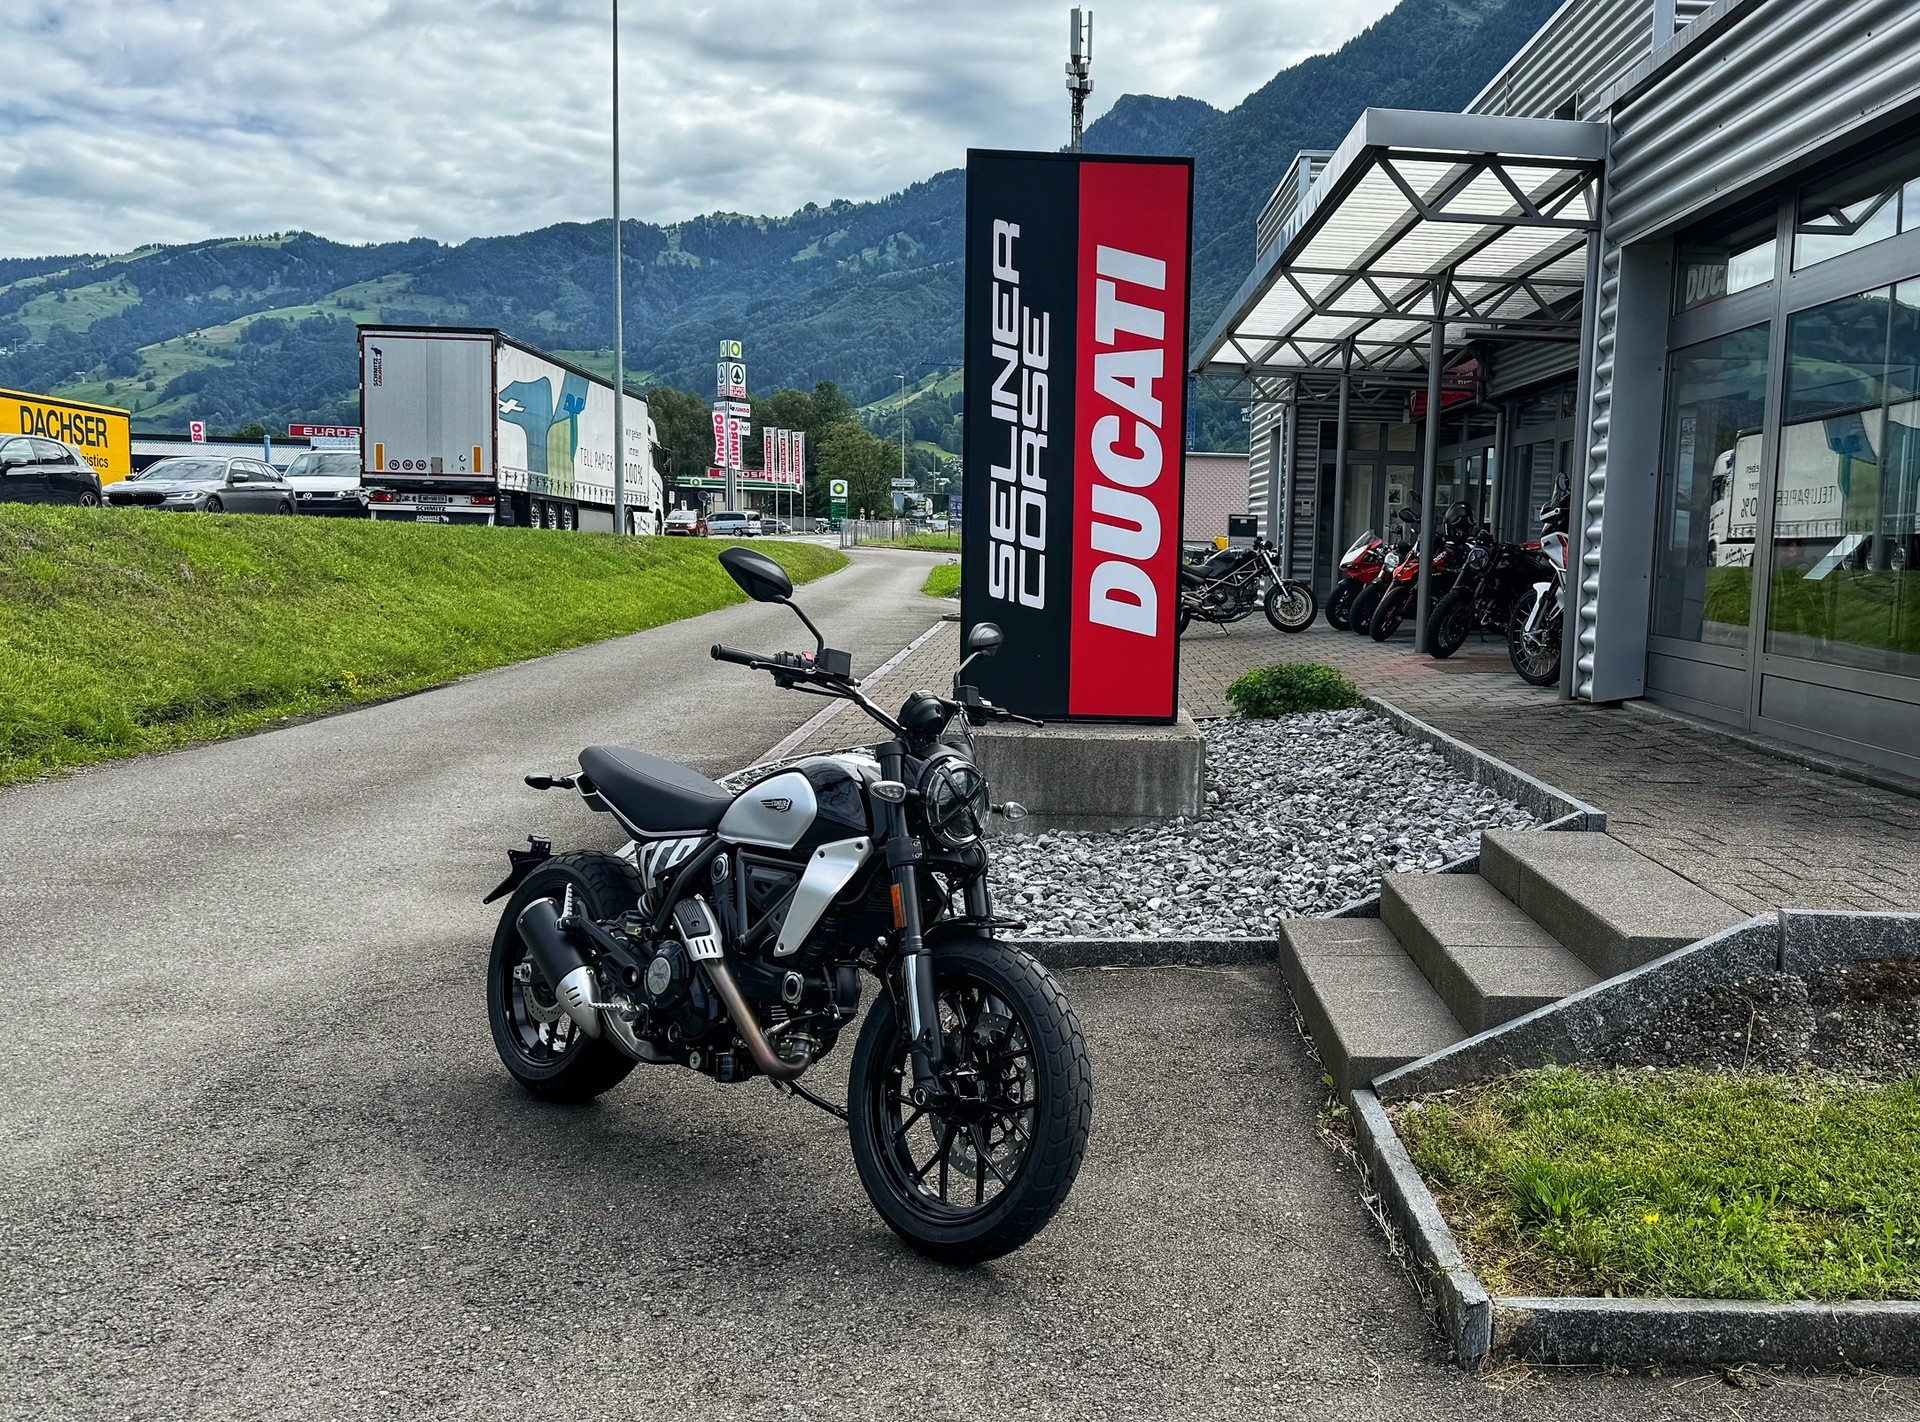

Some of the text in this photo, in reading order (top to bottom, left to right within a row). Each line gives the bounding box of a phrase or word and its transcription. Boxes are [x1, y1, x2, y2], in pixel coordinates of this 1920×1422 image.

[20, 405, 108, 448] DACHSER
[580, 447, 593, 468] TELL
[624, 462, 643, 485] 100%
[988, 218, 1021, 603] SELINER
[1018, 305, 1050, 609] CORSE
[1089, 244, 1167, 638] DUCATI
